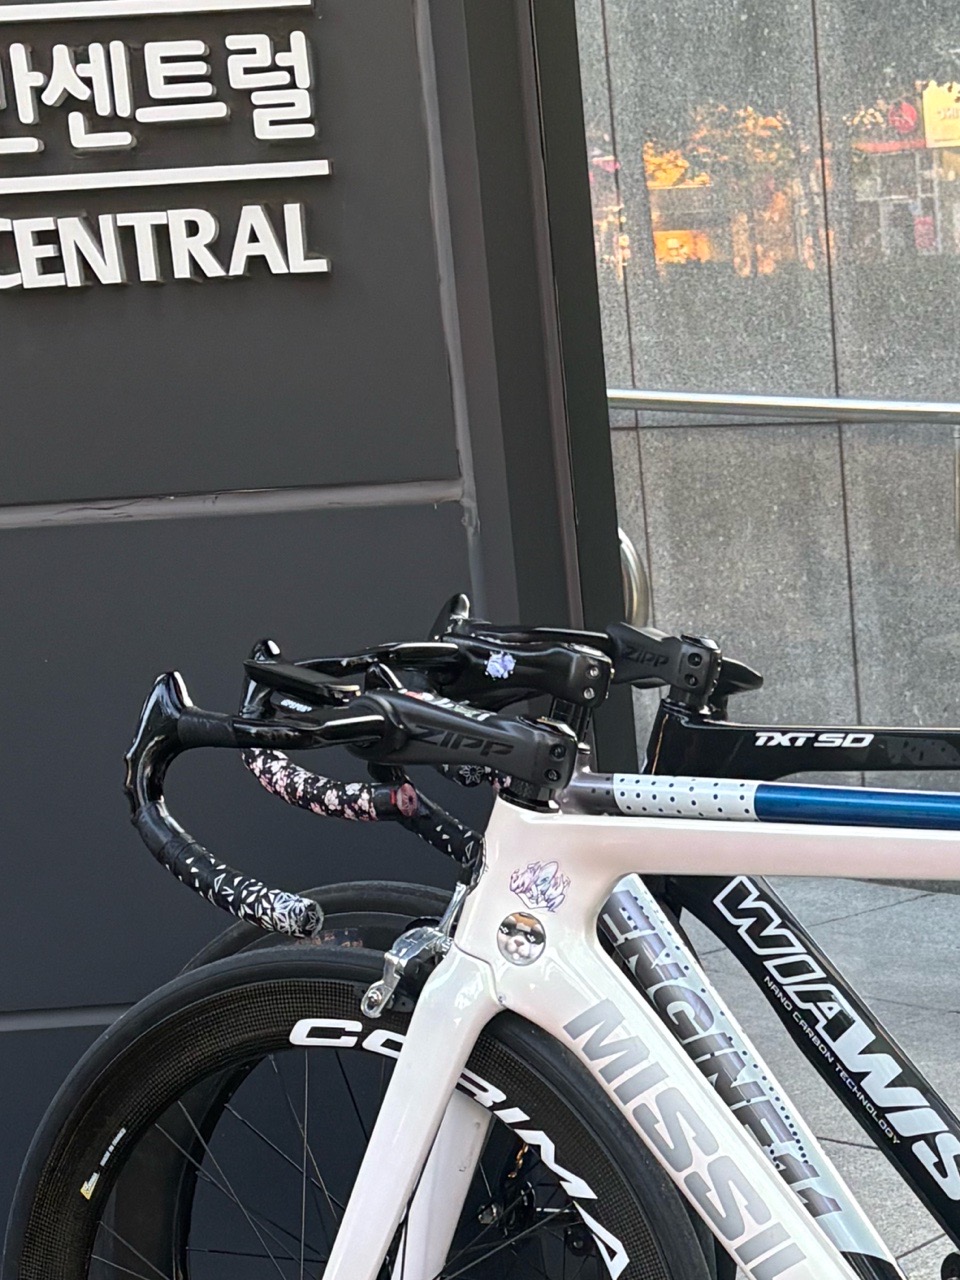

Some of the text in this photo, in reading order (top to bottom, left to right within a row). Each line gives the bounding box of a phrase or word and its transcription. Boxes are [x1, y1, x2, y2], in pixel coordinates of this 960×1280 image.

[411, 725, 515, 757] ZIPP
[754, 731, 875, 748] TXT SD
[764, 975, 901, 1145] NANO CARBON TECHNOLOGY
